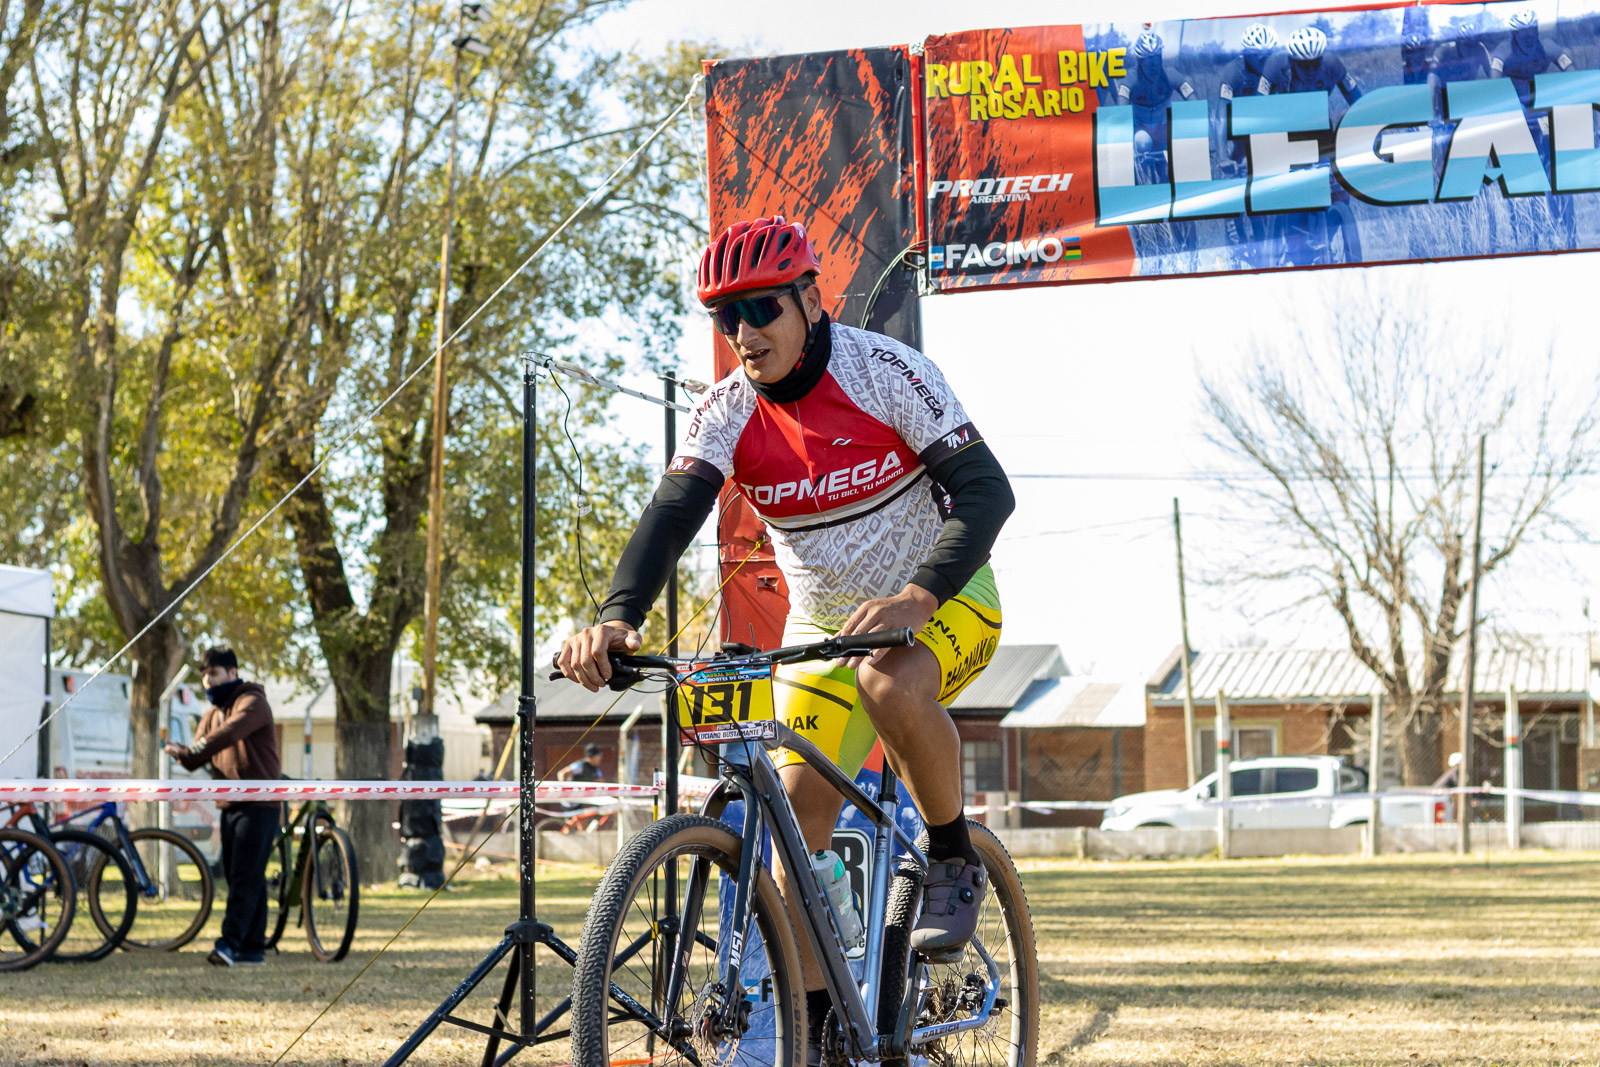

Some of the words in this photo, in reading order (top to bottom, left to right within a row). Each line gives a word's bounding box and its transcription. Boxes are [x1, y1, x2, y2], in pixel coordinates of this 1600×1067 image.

[926, 54, 1043, 99] RURAL
[1058, 47, 1127, 89] BIKE
[970, 86, 1085, 121] ROSARIO
[927, 173, 1073, 199] PROTECH
[969, 192, 1031, 204] ARGENTINA
[945, 237, 1064, 269] FACIMO
[869, 348, 945, 421] TOPMEGA
[942, 429, 970, 449] TM
[739, 450, 902, 505] TOPMEGA
[828, 494, 839, 502] TU
[862, 484, 874, 493] TU
[875, 467, 904, 488] MUNDO
[690, 682, 753, 724] 131
[697, 732, 721, 740] UCIANO
[921, 1023, 960, 1040] RALEIGH
